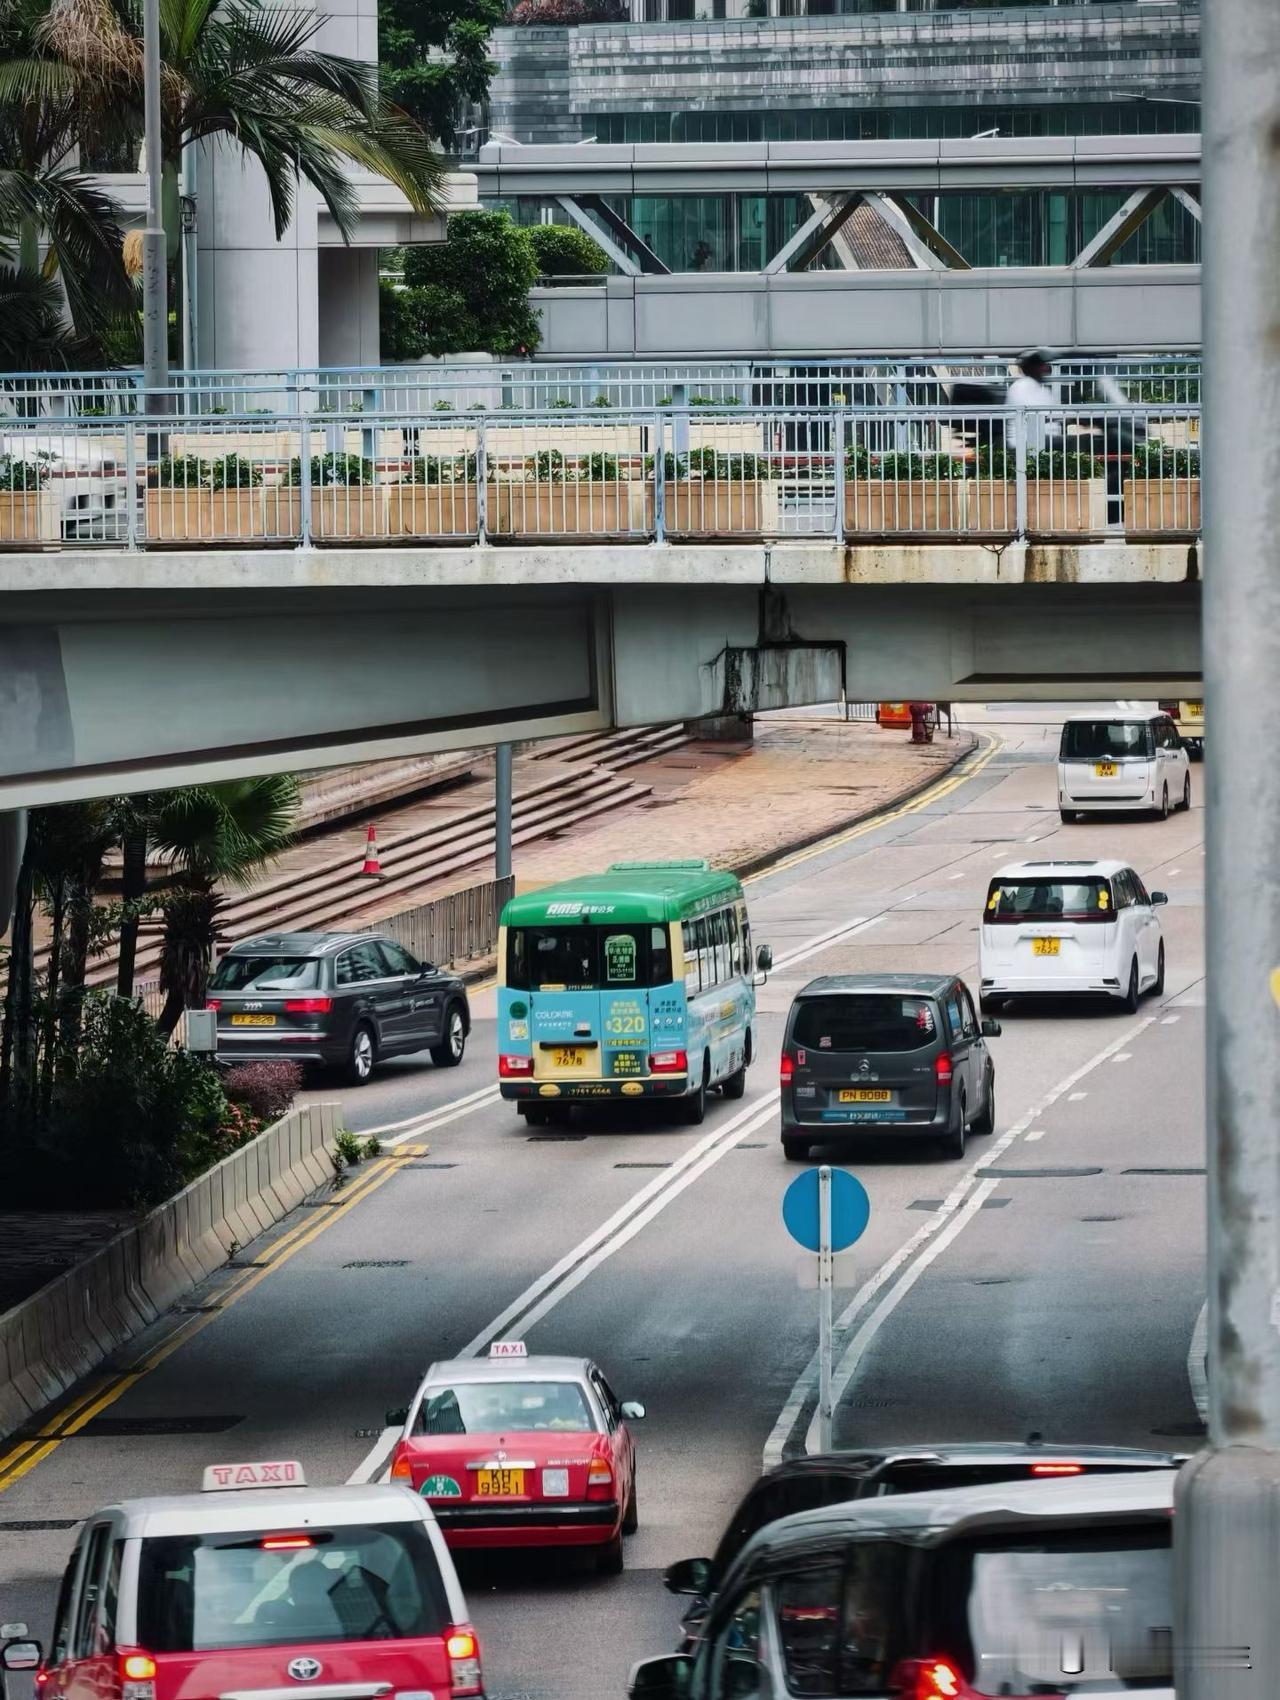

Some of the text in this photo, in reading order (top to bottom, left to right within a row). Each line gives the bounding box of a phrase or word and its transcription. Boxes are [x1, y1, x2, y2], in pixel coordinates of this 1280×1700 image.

[546, 903, 582, 915] AMS
[556, 1056, 583, 1066] 7678
[842, 1091, 857, 1100] PN
[493, 1344, 523, 1354] TAXI
[212, 1463, 295, 1485] TAXI
[481, 1481, 520, 1495] 9951
